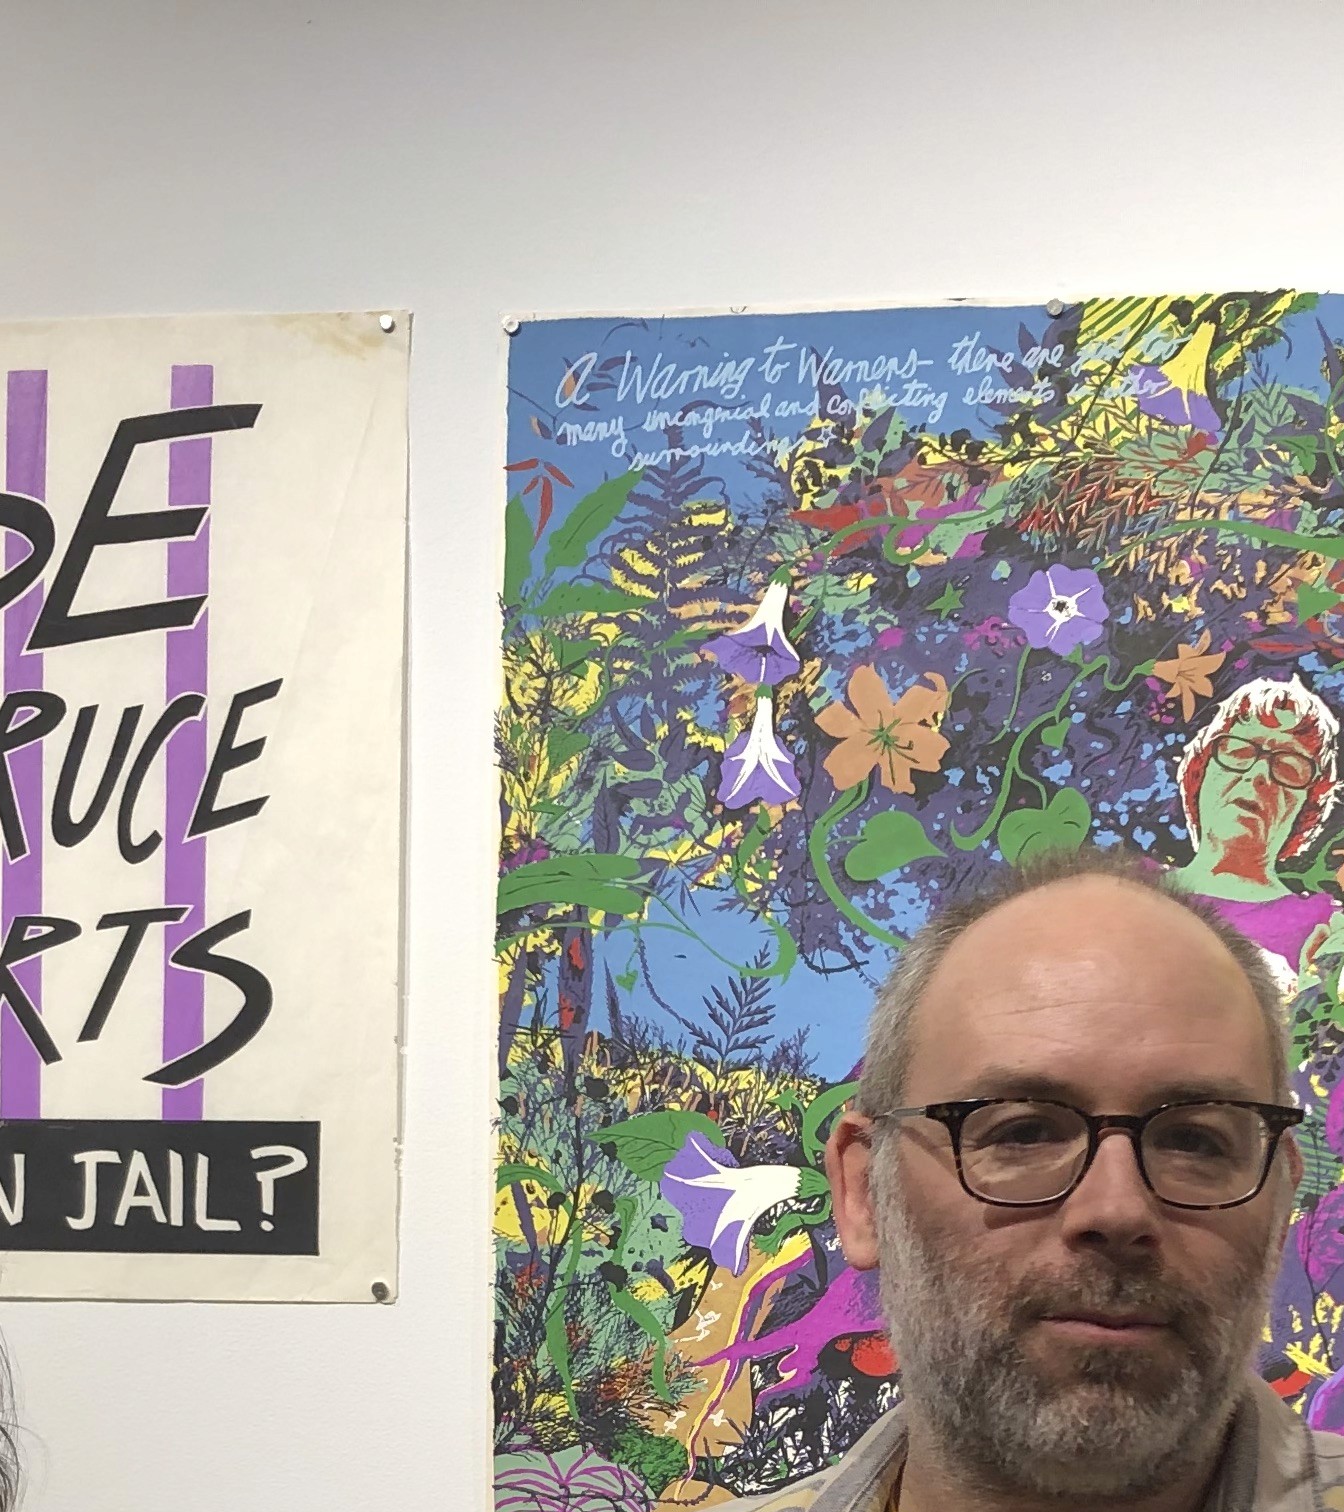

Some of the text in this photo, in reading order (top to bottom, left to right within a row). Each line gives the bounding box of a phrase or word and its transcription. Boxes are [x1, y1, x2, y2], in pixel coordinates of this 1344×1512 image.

[617, 349, 755, 404] Warning
[758, 336, 797, 384] to
[949, 332, 1014, 375] there
[1022, 344, 1064, 371] are
[557, 416, 628, 457] many
[775, 390, 820, 417] and
[962, 376, 1055, 405] elements
[65, 1145, 308, 1232] JAIL?
